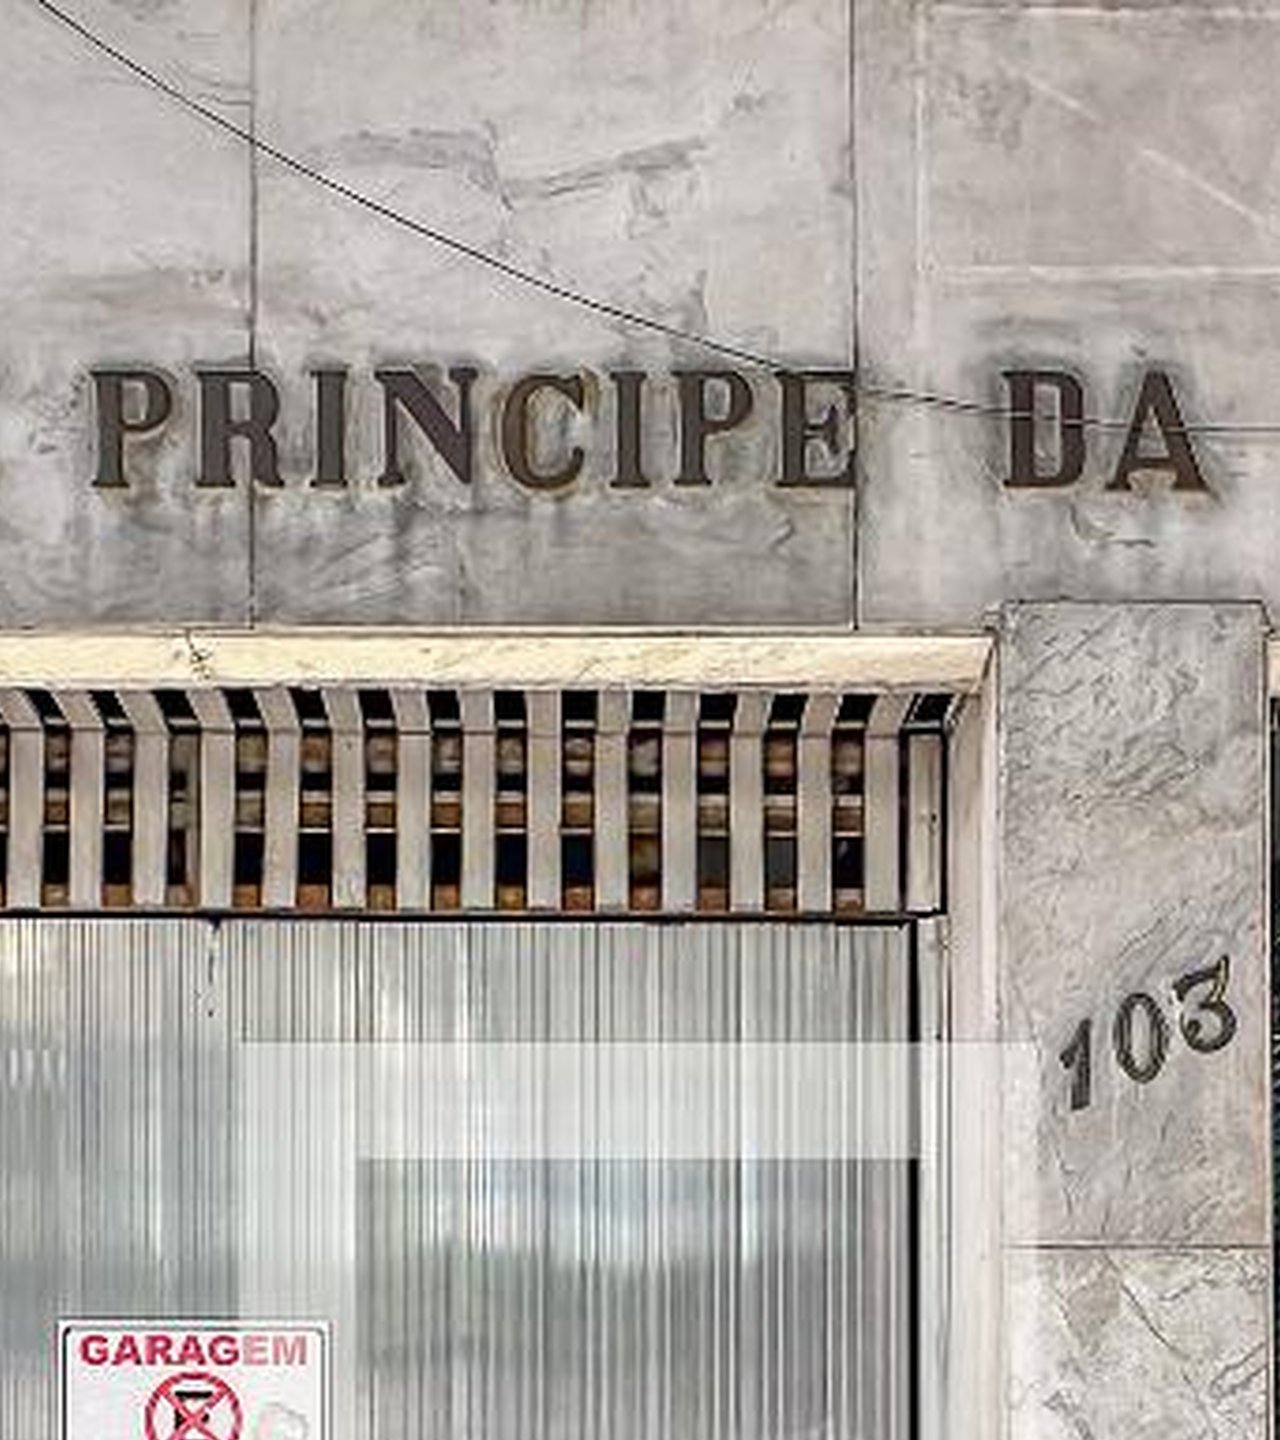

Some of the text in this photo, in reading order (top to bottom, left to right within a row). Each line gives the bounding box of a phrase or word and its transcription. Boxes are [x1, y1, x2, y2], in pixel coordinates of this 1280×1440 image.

[91, 370, 857, 489] PRINCIPE
[999, 370, 1211, 492] DA
[1059, 955, 1237, 1111] 103
[79, 1334, 307, 1366] GARAGEM
